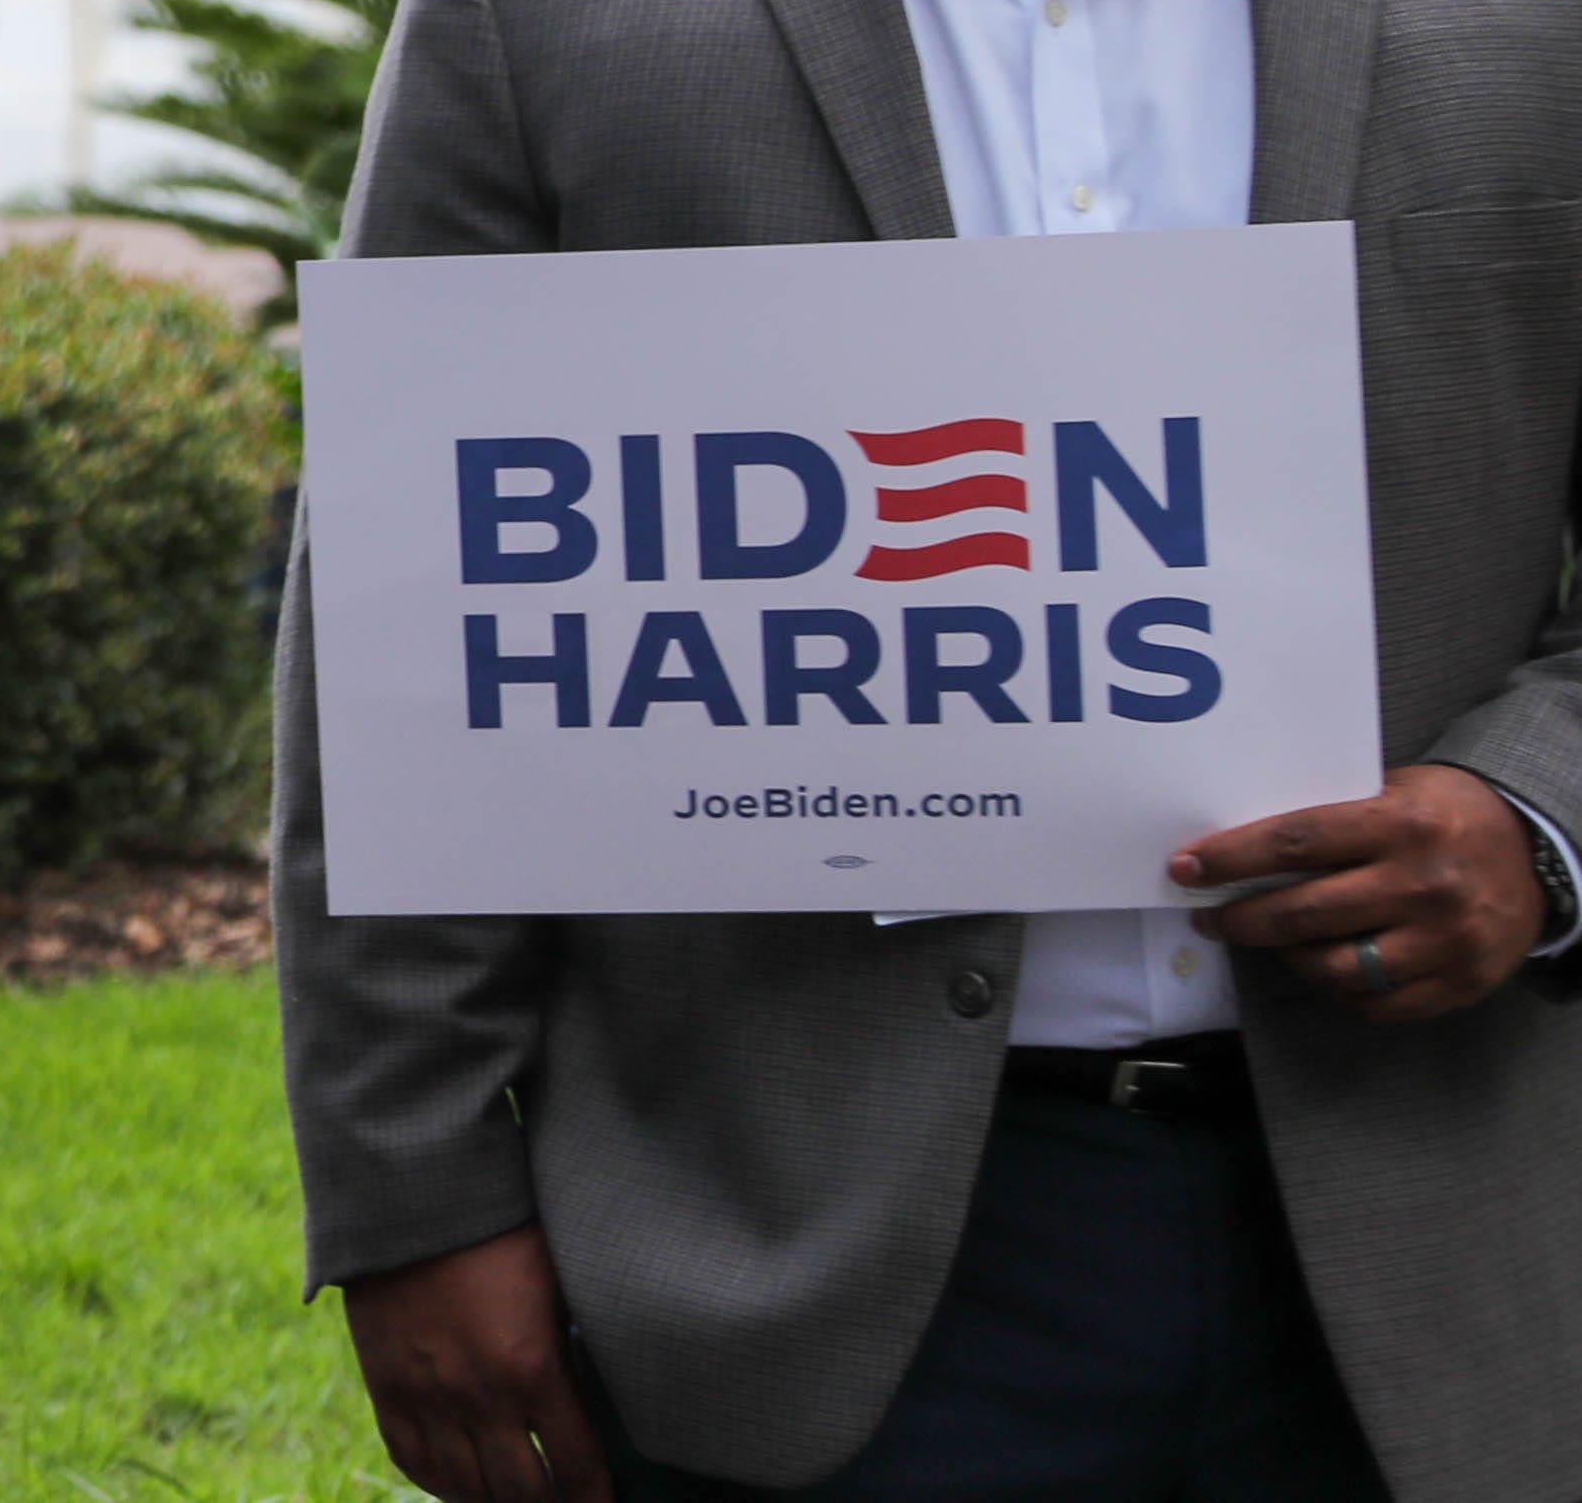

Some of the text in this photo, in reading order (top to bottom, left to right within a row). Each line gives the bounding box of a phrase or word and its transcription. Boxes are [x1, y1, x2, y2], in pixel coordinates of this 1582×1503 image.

[456, 416, 1209, 586] BIDEN
[464, 597, 1223, 730] HARRIS
[674, 785, 1022, 820] JoeBiden.com
